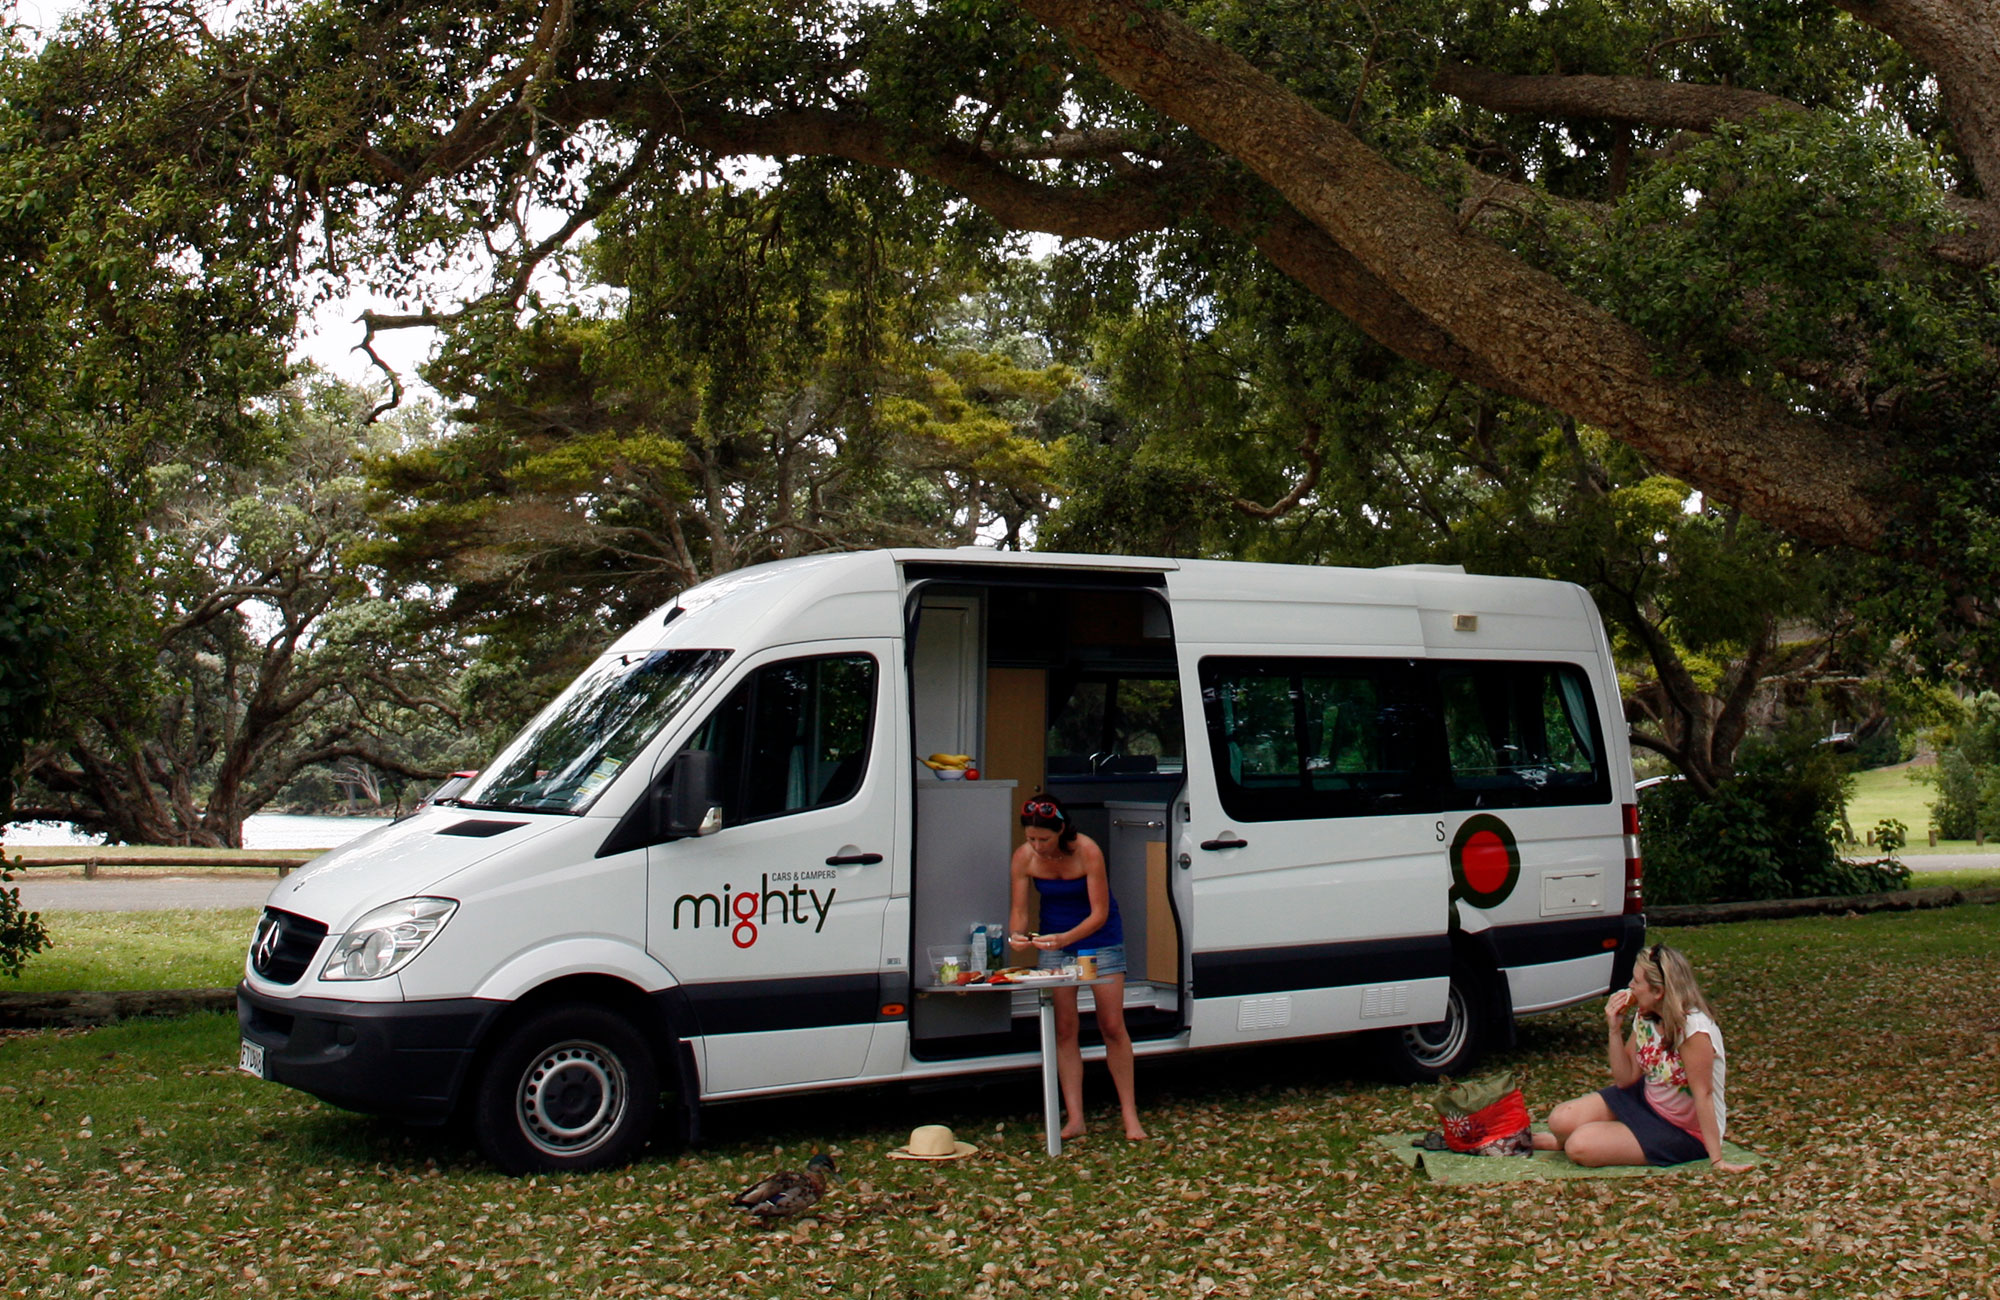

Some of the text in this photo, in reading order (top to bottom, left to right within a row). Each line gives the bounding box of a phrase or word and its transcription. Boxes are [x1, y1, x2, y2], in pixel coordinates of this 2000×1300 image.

[1435, 820, 1446, 842] S
[771, 870, 837, 882] CARS & CAMPERS
[673, 873, 837, 949] mighty
